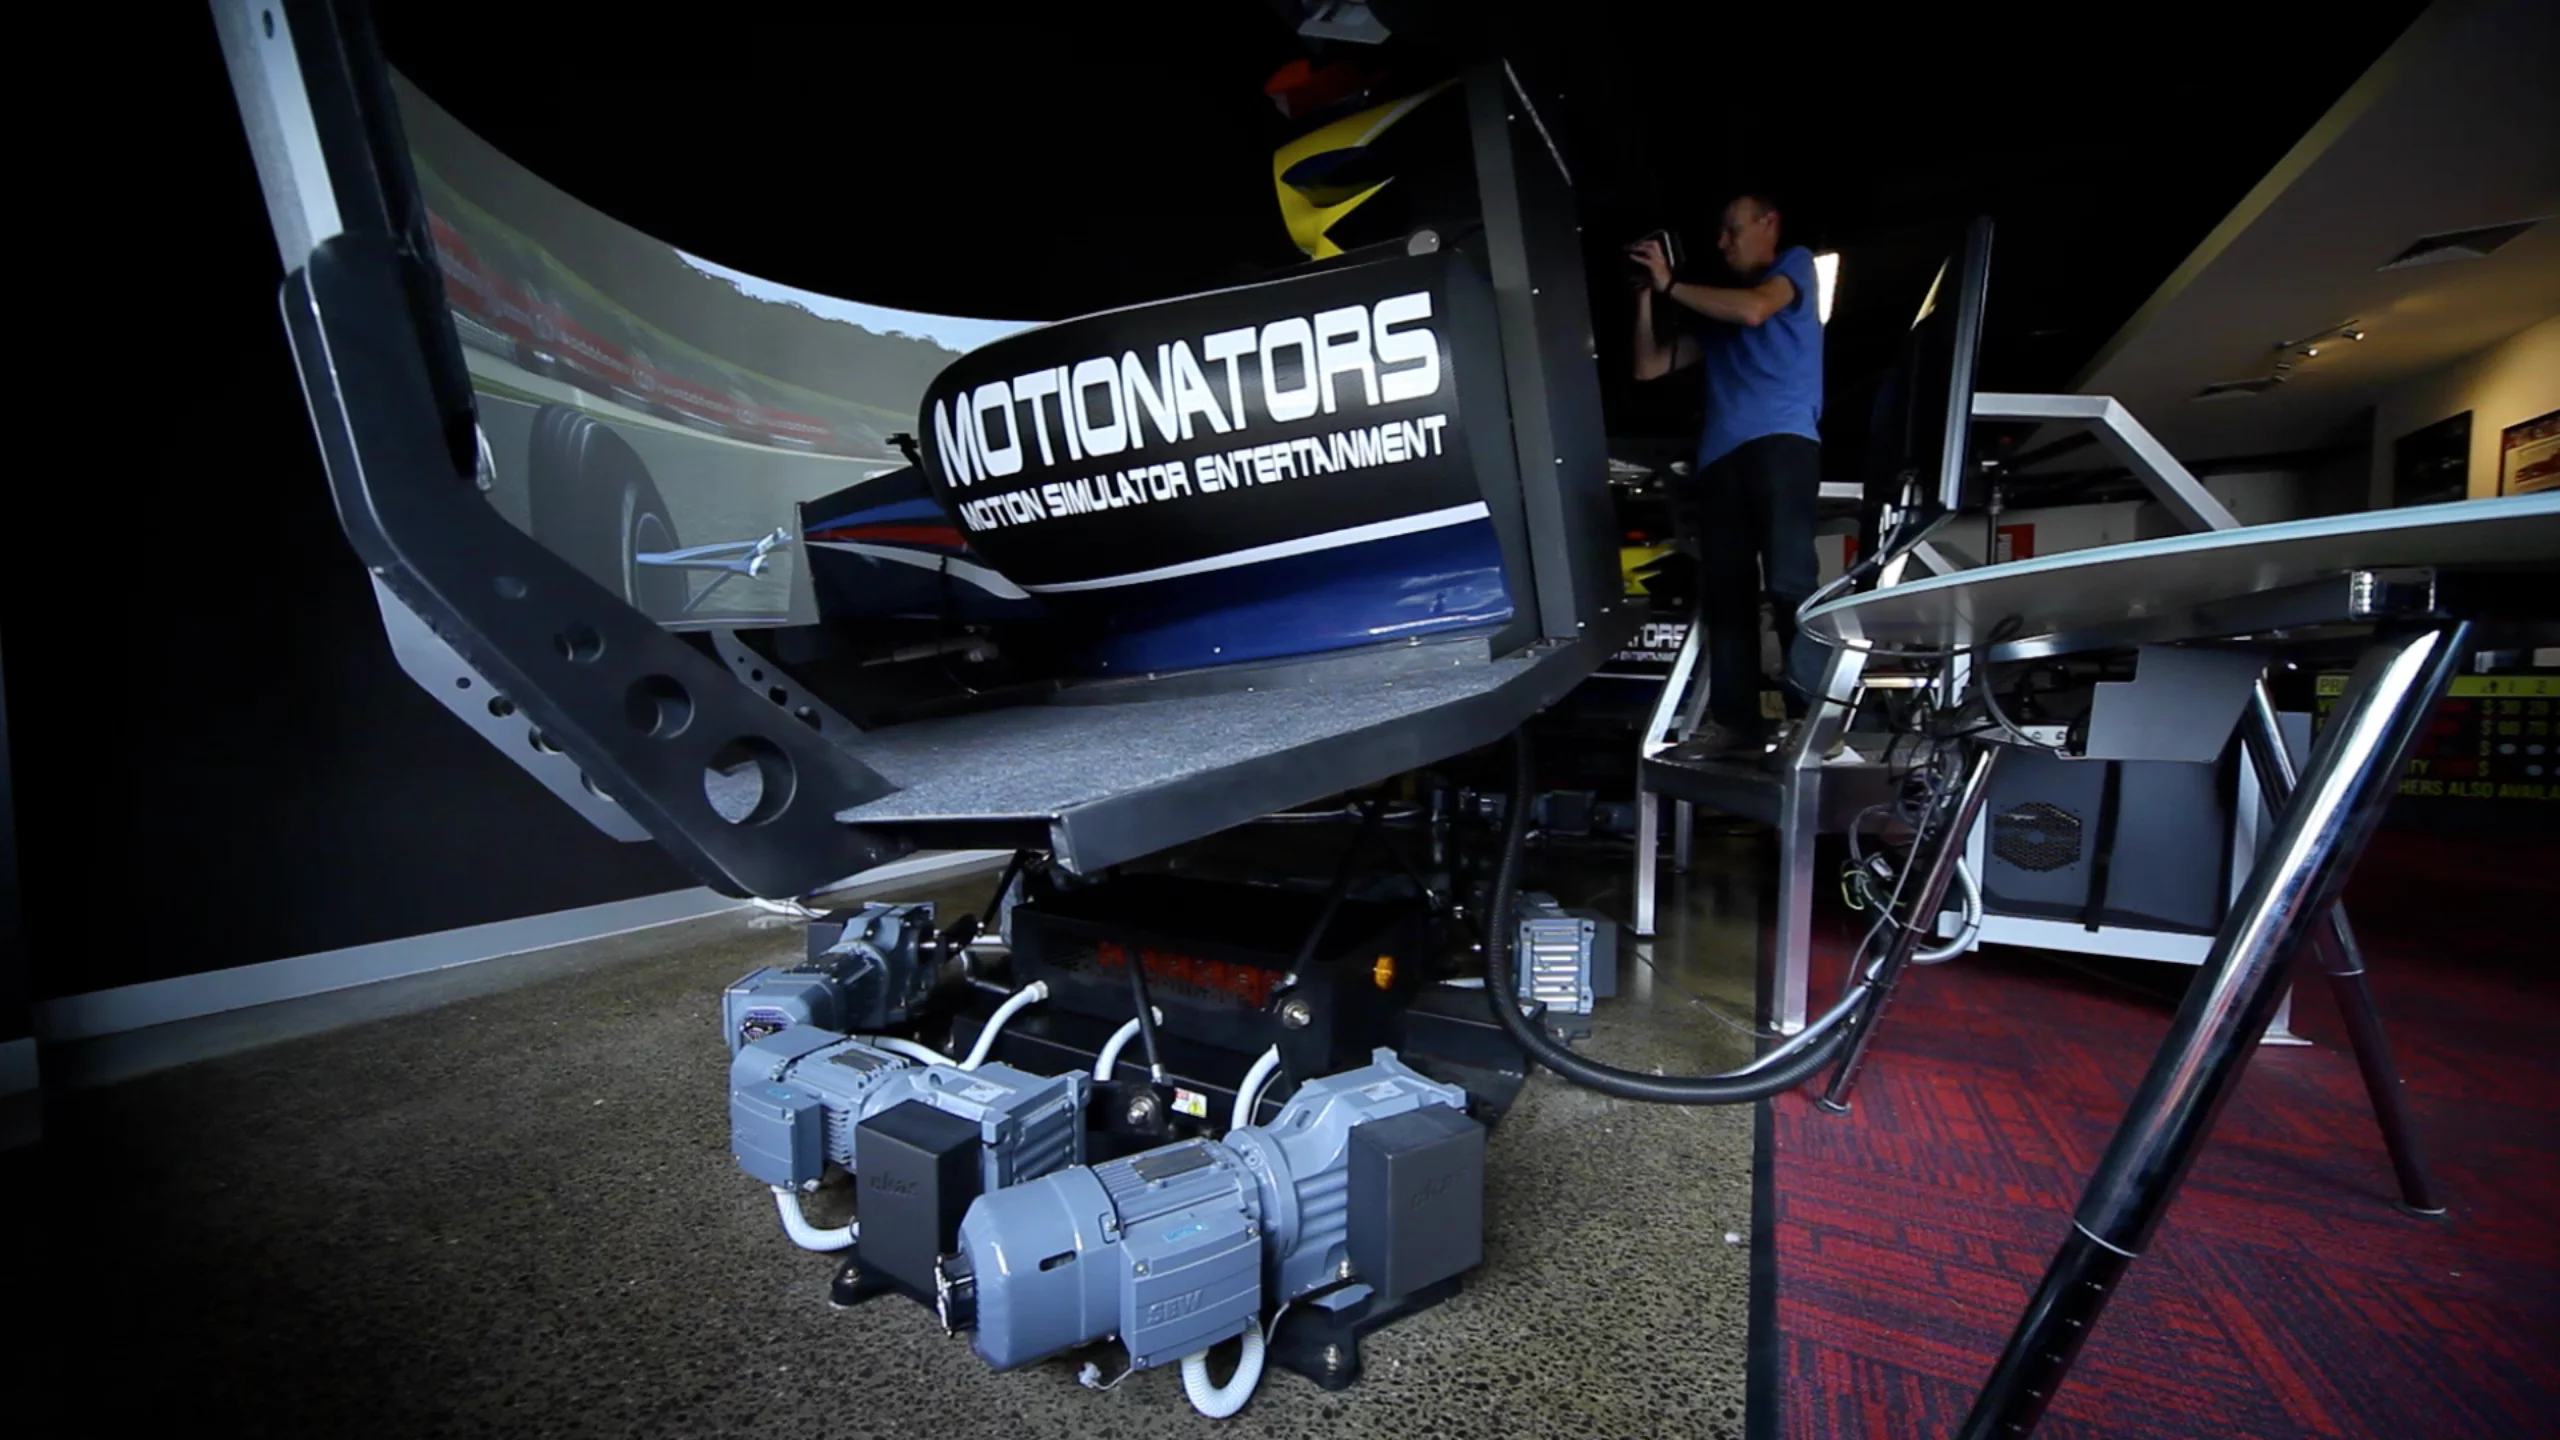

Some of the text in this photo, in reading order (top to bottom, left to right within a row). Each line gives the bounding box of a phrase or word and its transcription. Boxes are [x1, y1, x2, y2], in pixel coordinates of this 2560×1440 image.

[933, 291, 1440, 488] MOTIONATORS
[959, 414, 1447, 533] MOTION SIMULATOR ENTERTAINMENT
[2396, 779, 2443, 796] HERS
